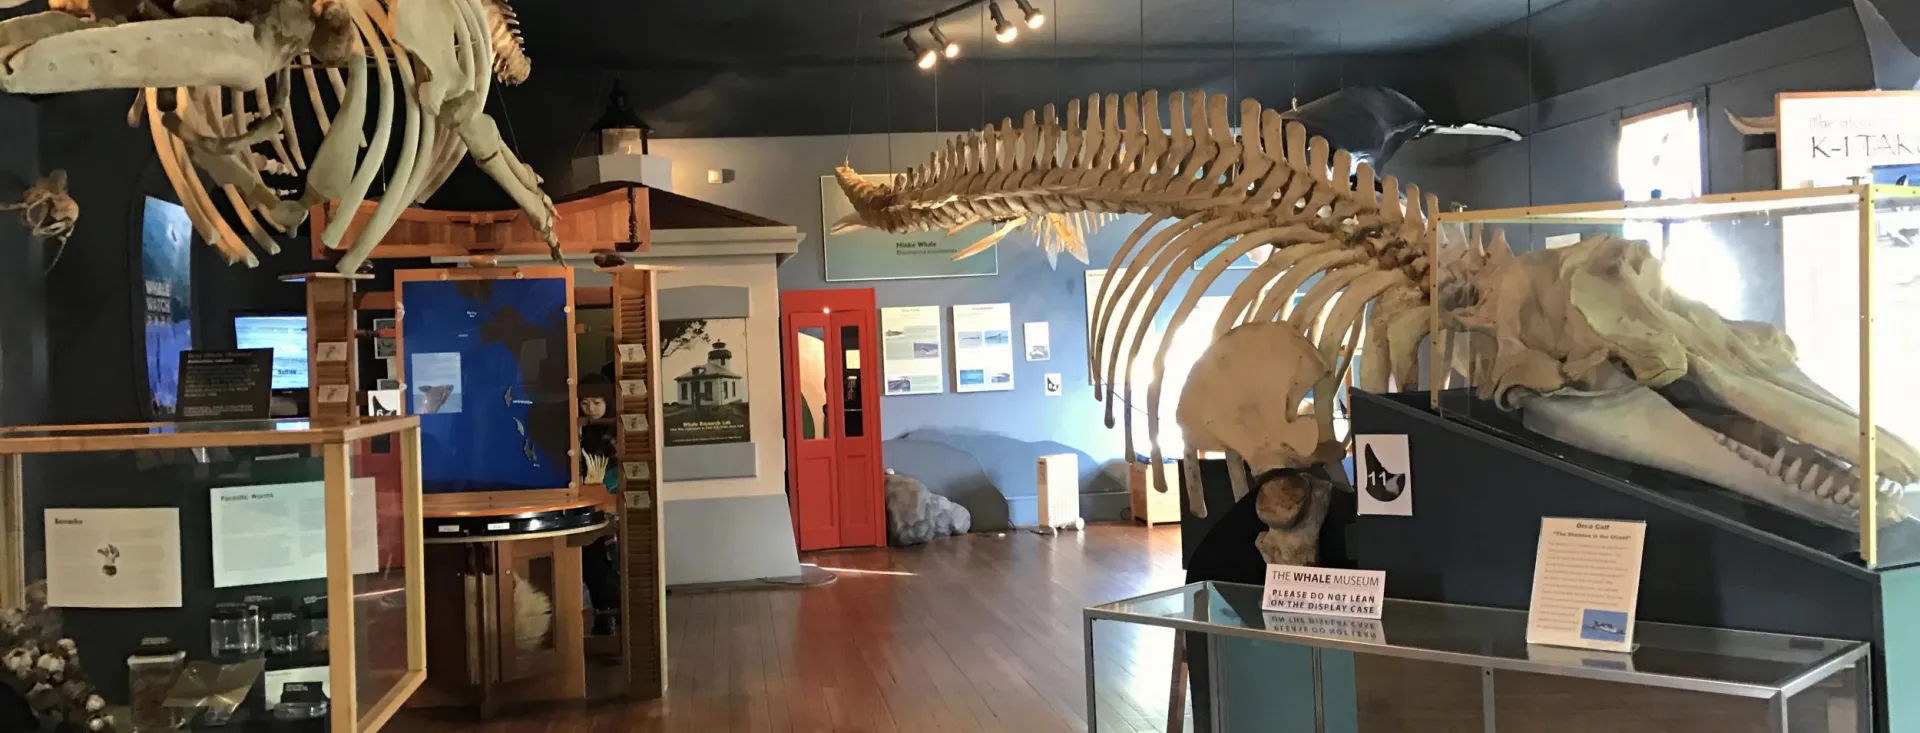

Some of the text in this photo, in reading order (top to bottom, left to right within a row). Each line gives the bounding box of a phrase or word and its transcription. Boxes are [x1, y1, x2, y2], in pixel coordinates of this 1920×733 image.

[146, 297, 170, 313] WATCH
[1368, 470, 1387, 486] 11
[1272, 570, 1379, 587] THE WHALE MUSEUM
[1272, 589, 1375, 603] PLEASE DO NOT LEAN
[1287, 600, 1304, 608] THE
[1307, 602, 1347, 612] DISPLAY
[1350, 605, 1374, 614] CASE
